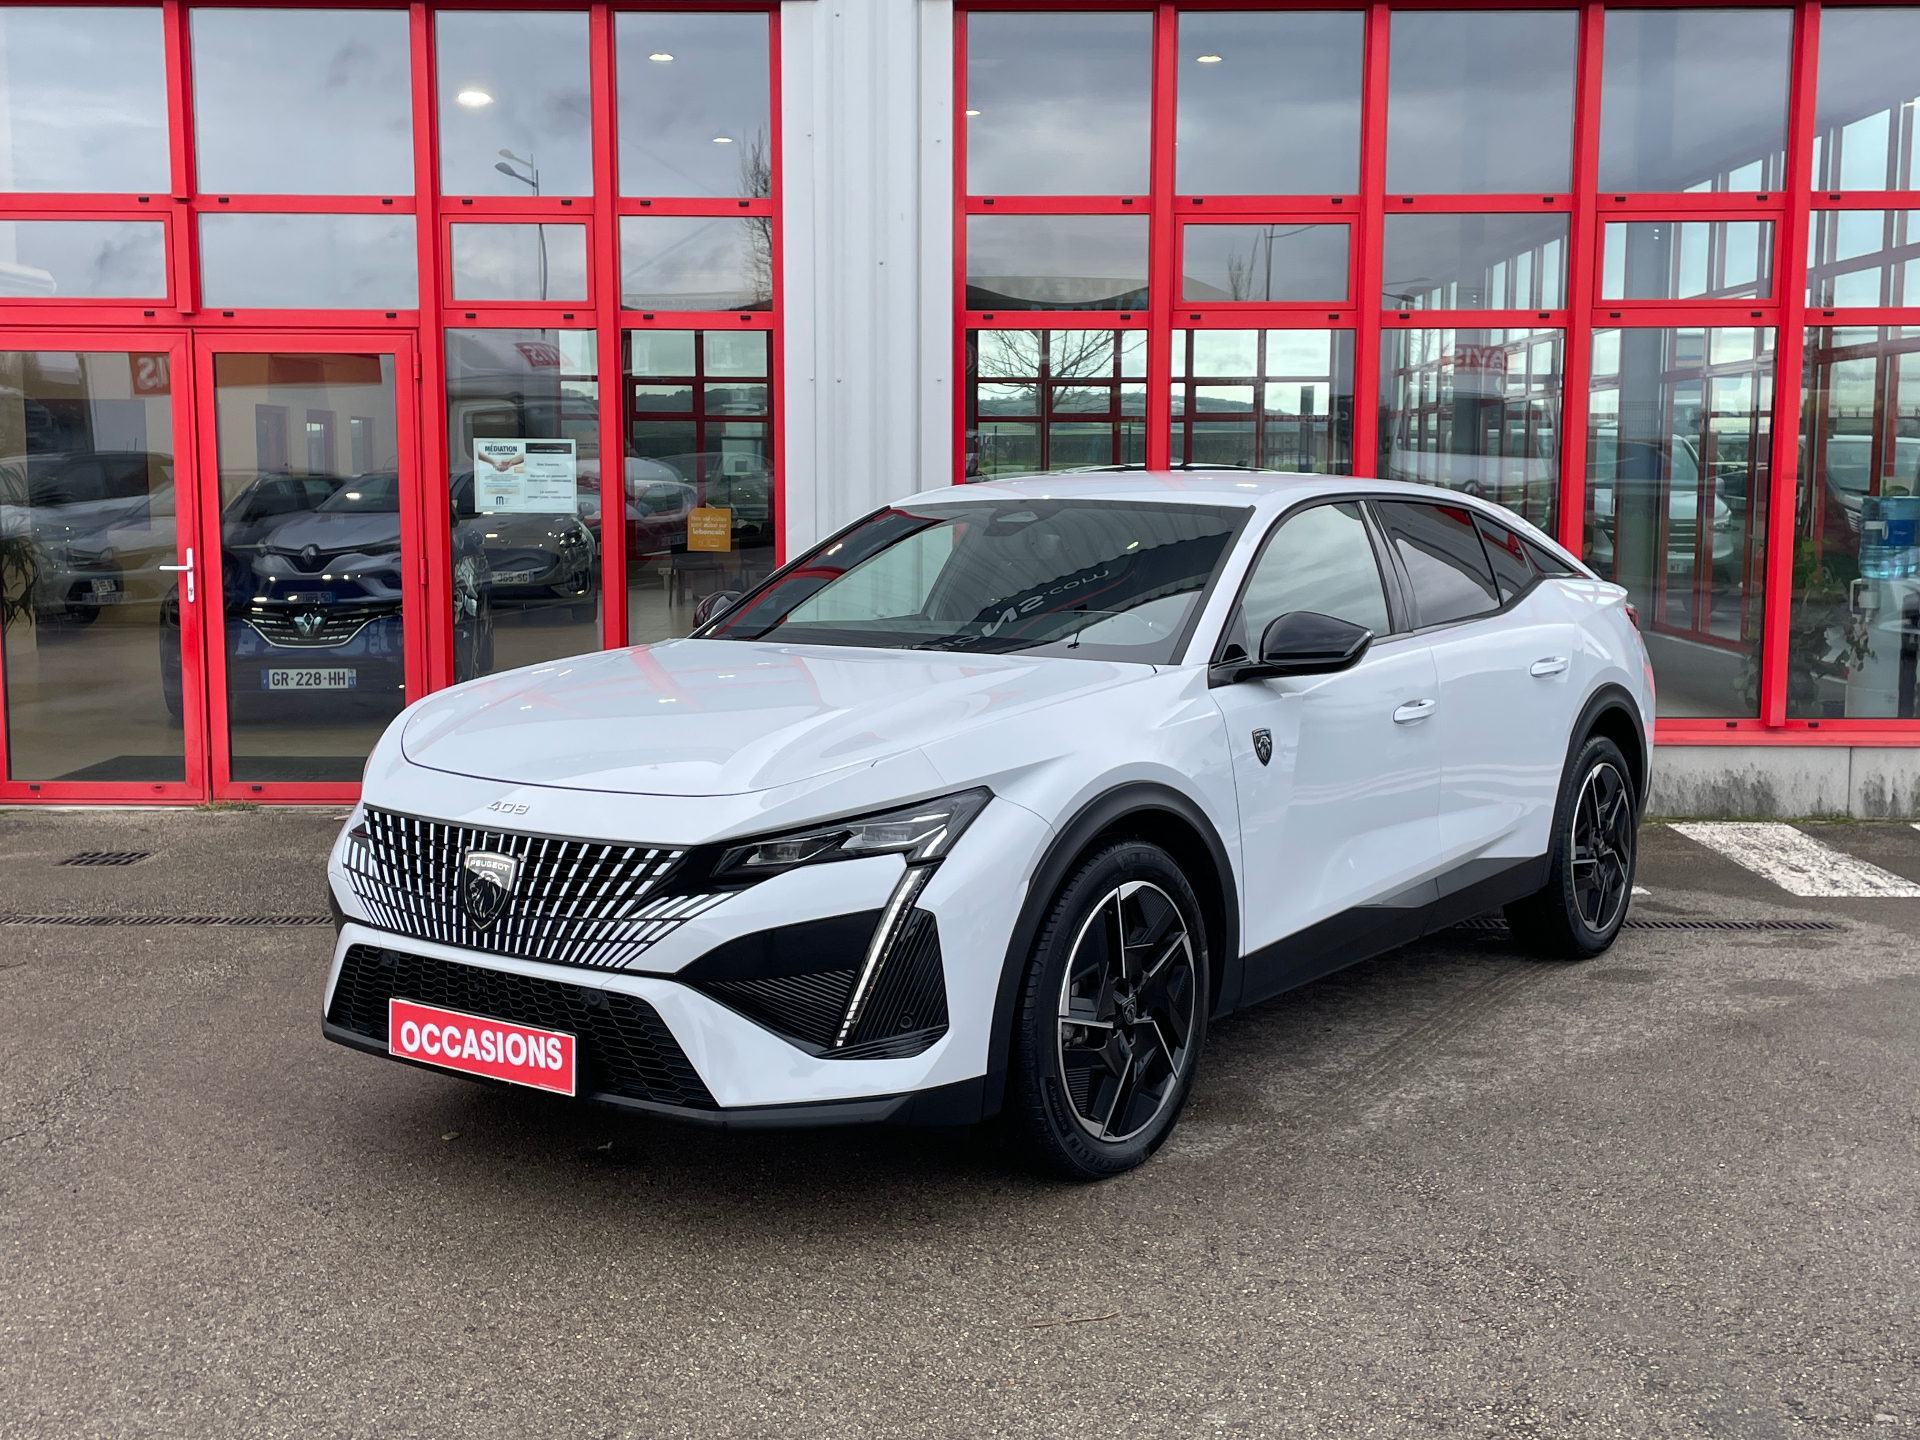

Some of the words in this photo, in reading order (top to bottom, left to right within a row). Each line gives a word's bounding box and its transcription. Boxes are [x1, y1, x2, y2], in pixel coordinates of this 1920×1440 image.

[484, 443, 518, 453] MÉDIATION
[692, 528, 726, 536] leboncoin
[272, 671, 346, 687] GR-228-HH
[487, 801, 530, 815] 408
[469, 859, 510, 872] PEUGEOT
[400, 1020, 563, 1071] OCCASIONS
